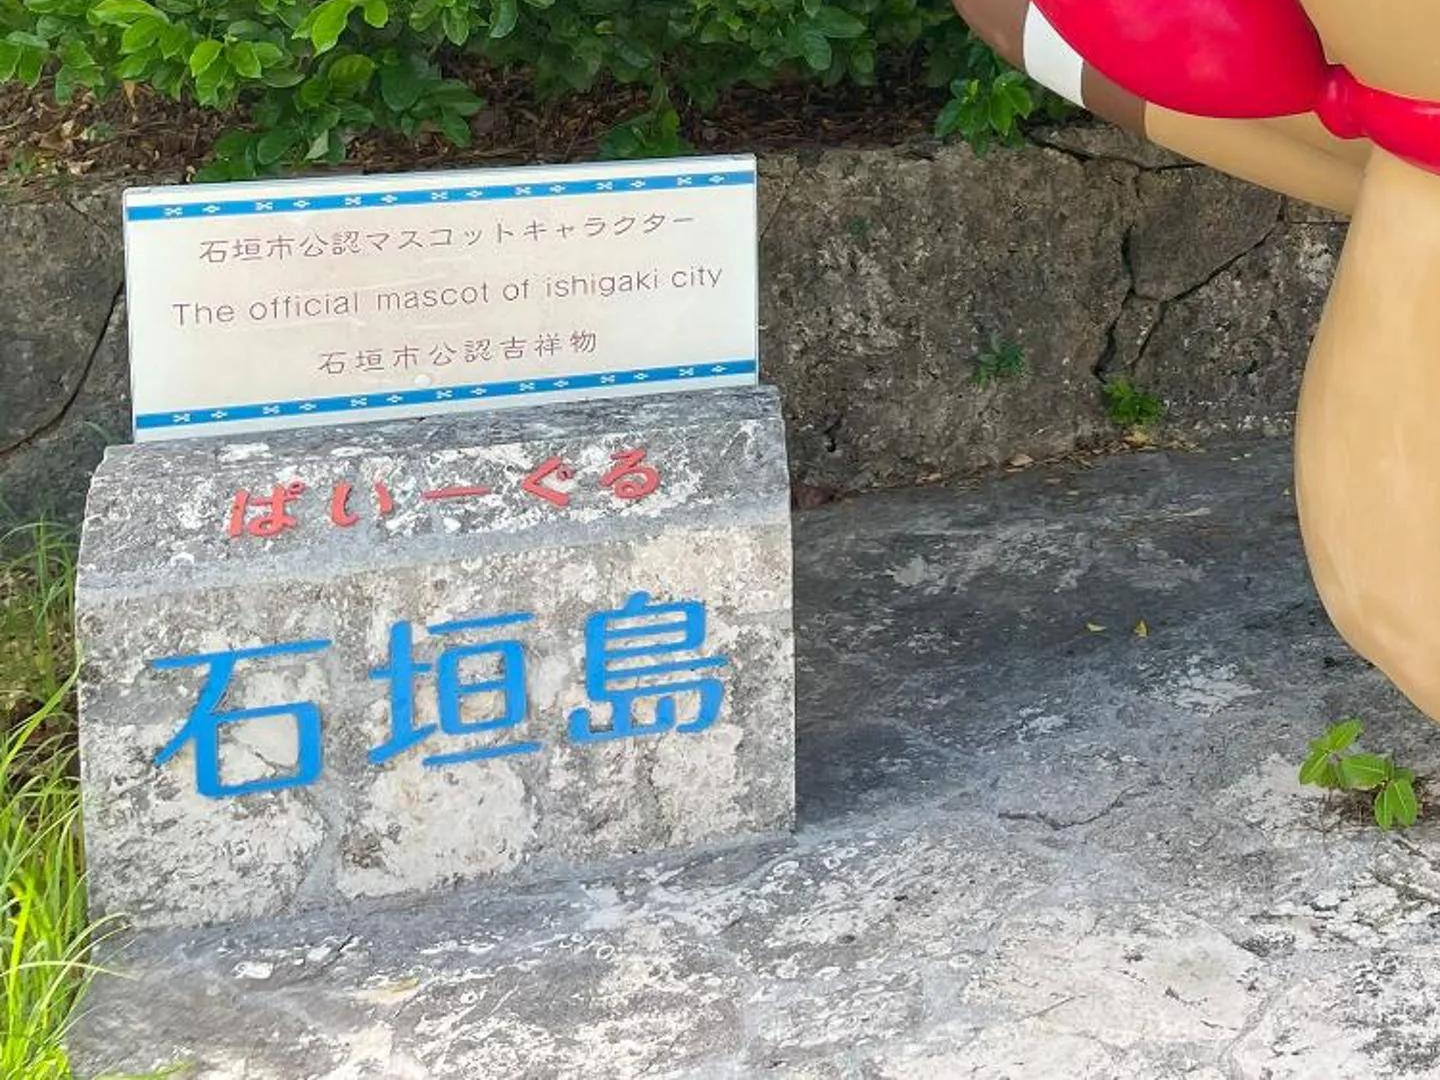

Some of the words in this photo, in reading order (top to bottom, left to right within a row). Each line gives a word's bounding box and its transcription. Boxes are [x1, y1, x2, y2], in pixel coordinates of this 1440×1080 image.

[199, 212, 695, 263] 石垣市公認マスコットキャラクター
[173, 302, 236, 326] The
[249, 292, 360, 321] official
[377, 282, 490, 310] mascot
[502, 278, 531, 302] of
[545, 268, 660, 299] ishigaki
[671, 264, 724, 290] city
[318, 330, 597, 376] 石垣市公認吉祥物
[229, 448, 662, 538] ぱいーぐる
[151, 591, 730, 798] 石垣島
